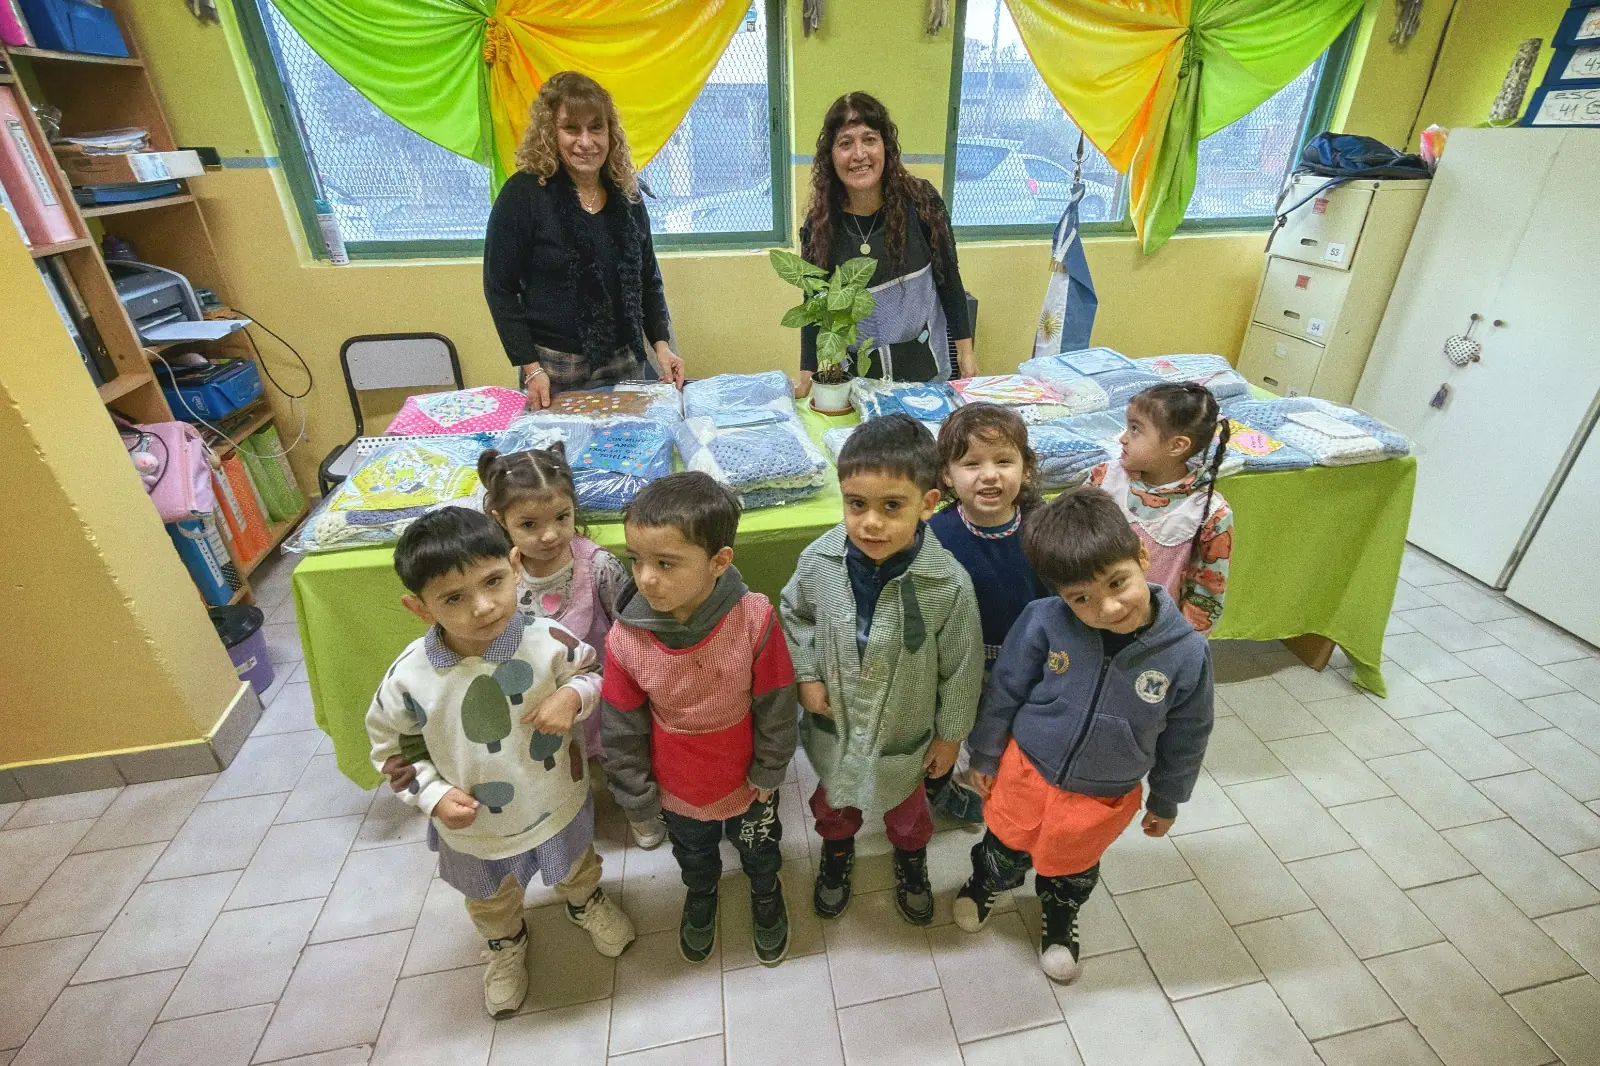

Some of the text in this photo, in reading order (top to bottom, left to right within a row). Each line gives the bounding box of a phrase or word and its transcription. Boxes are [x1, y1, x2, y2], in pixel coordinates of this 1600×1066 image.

[1559, 103, 1579, 117] 41
[1330, 247, 1340, 257] 53
[1311, 322, 1321, 332] 54
[1143, 676, 1164, 696] M
